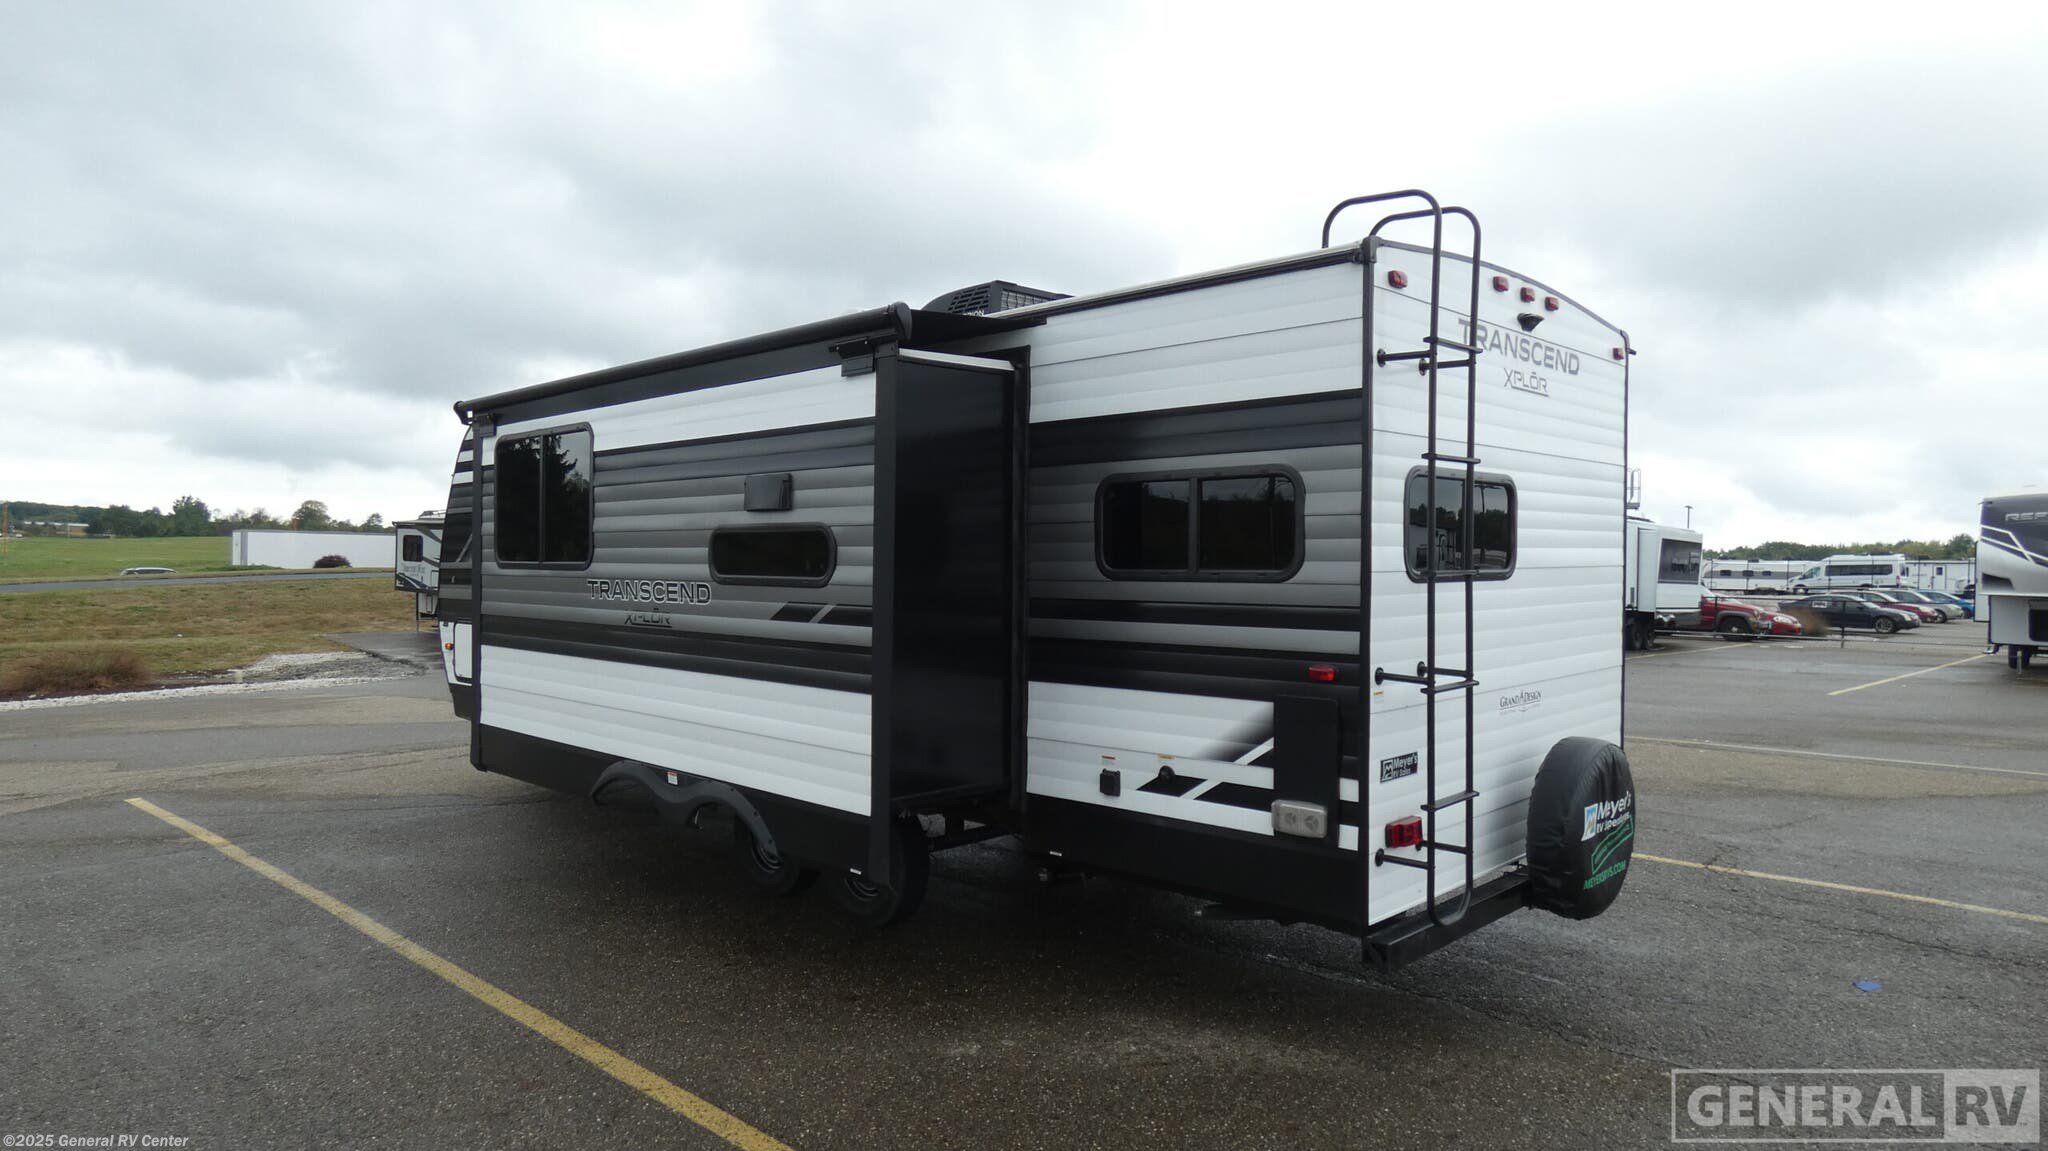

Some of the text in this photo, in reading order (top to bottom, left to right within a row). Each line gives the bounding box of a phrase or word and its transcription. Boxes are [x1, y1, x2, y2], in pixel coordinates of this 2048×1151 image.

[1458, 317, 1580, 376] TRANSCEND
[587, 579, 712, 606] TRANSCEND
[1597, 790, 1632, 820] Meyer's
